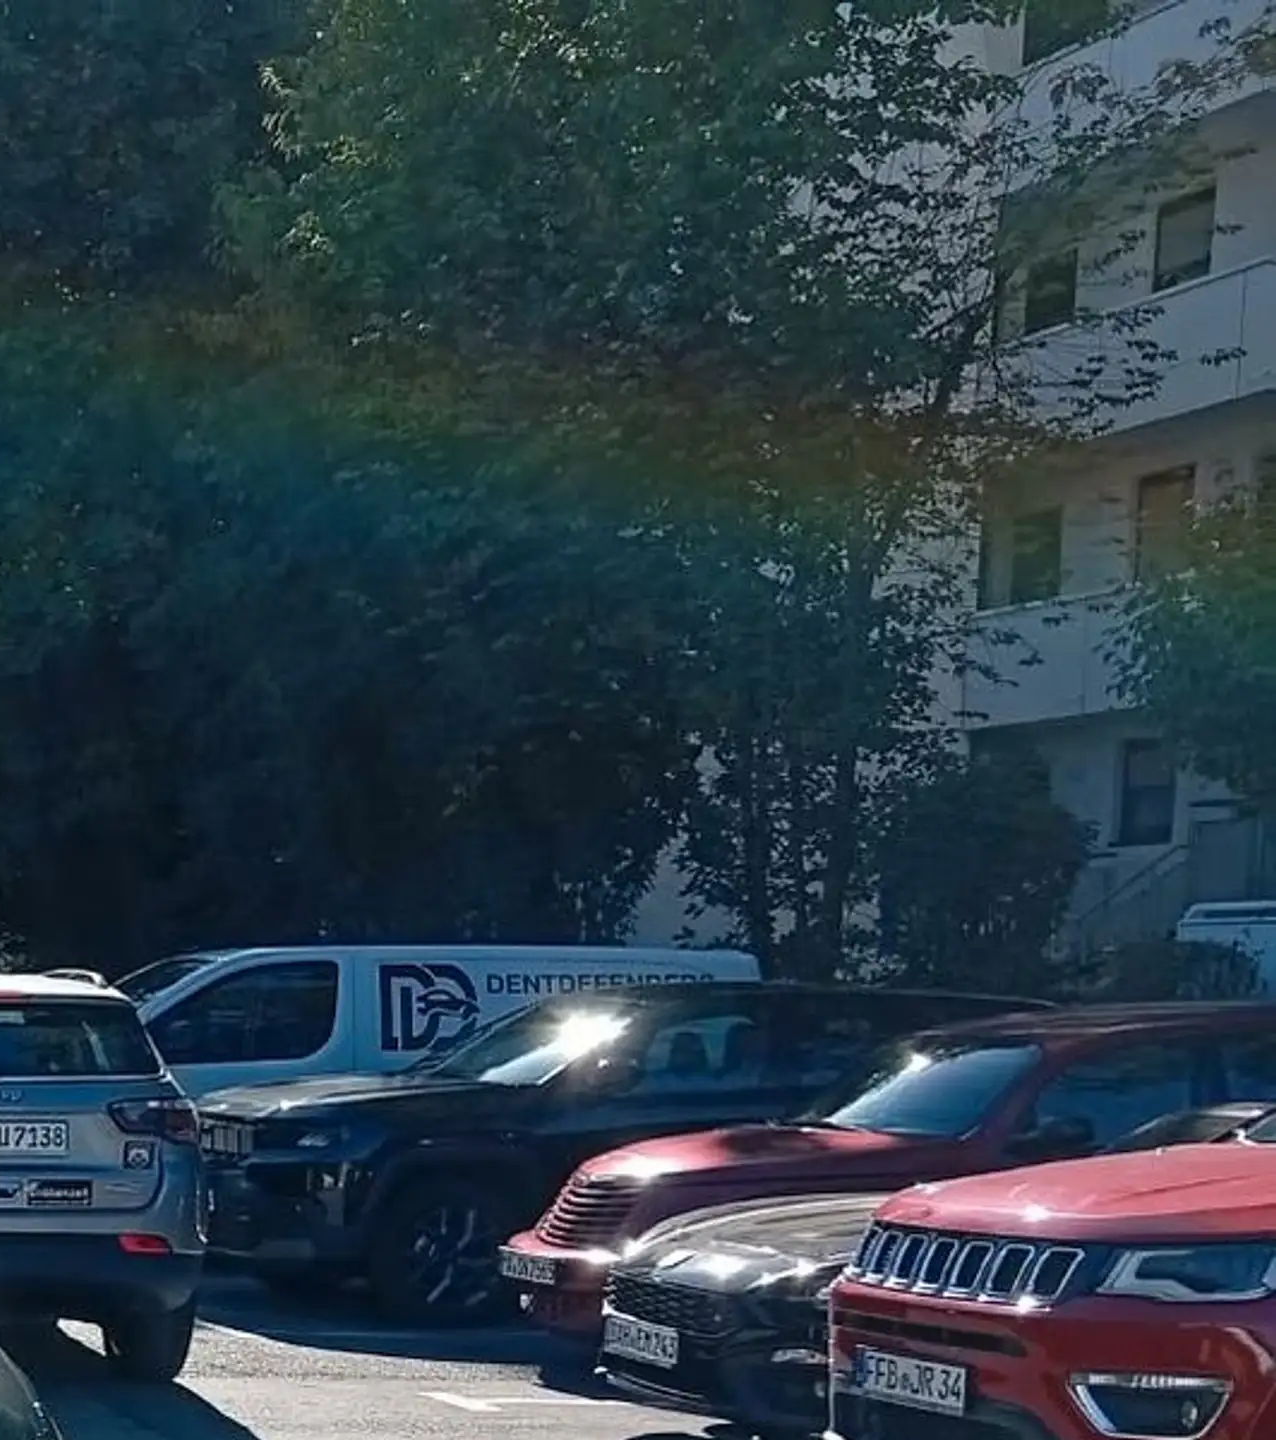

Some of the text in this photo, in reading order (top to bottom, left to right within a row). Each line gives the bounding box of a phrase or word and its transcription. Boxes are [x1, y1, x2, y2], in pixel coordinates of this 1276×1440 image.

[866, 1354, 963, 1401] FFB JR 34
